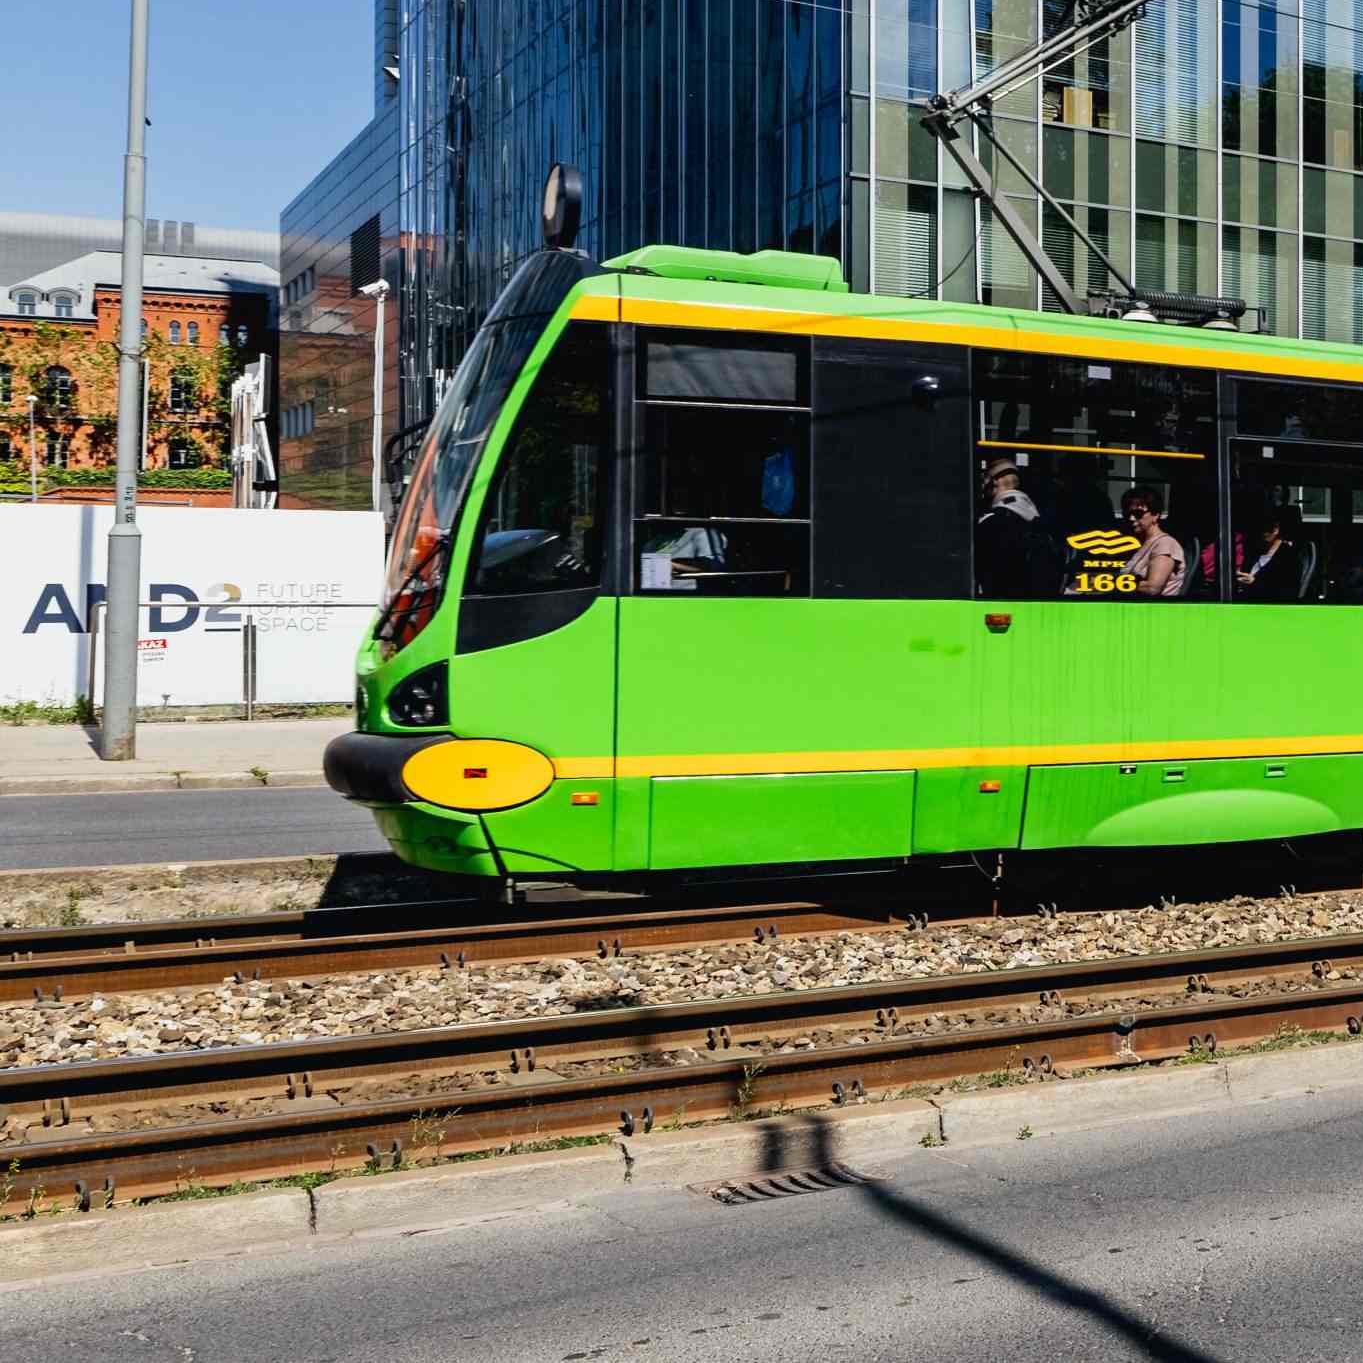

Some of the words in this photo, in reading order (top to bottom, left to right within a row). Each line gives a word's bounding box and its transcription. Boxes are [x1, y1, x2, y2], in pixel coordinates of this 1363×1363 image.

[1083, 560, 1127, 568] MPK
[257, 583, 343, 598] FUTURE
[1075, 573, 1137, 593] 166
[257, 616, 328, 632] SPACE
